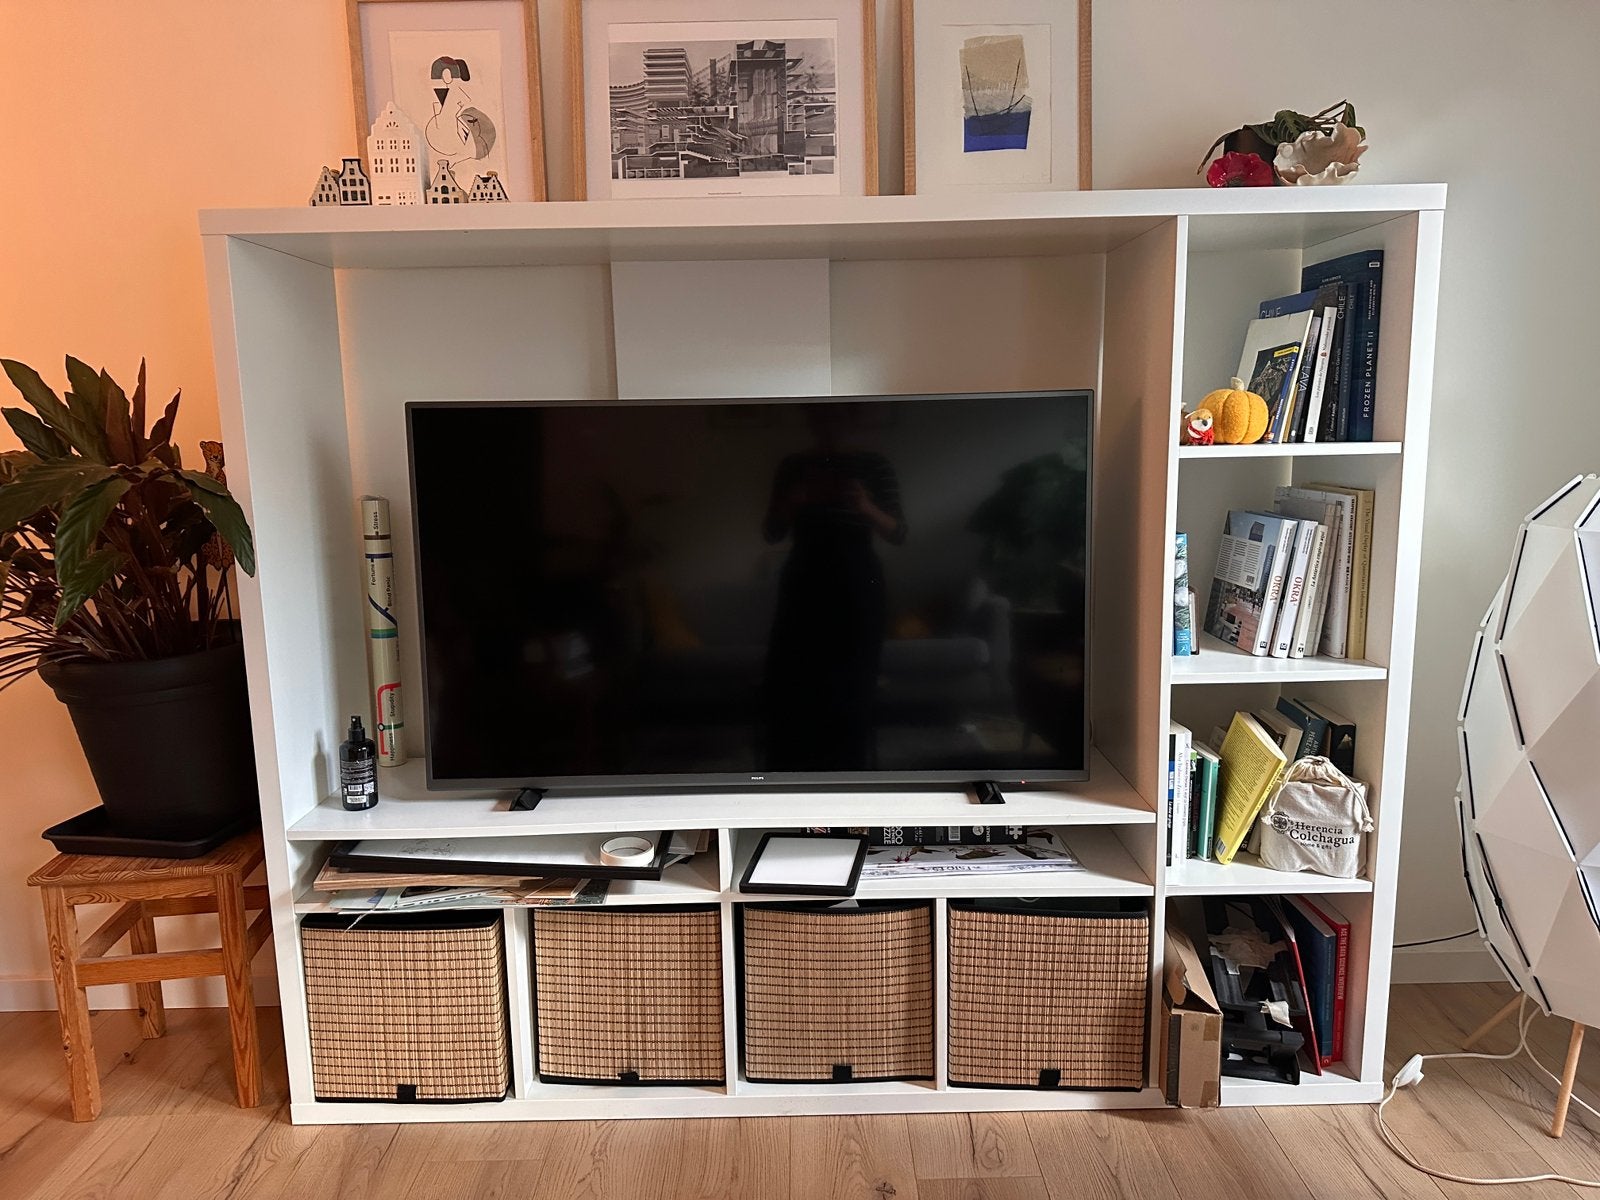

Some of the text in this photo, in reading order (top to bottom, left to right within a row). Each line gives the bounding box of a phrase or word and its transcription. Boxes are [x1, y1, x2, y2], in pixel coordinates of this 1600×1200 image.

[1337, 295, 1346, 320] CHILE
[1366, 341, 1374, 377] PLANET
[1298, 366, 1311, 392] LAVA
[1363, 381, 1371, 418] FROZEN
[1269, 575, 1283, 601] OKRA
[1289, 576, 1302, 603] OKRA
[1290, 829, 1355, 848] Colchagua
[1294, 821, 1343, 835] Herencia
